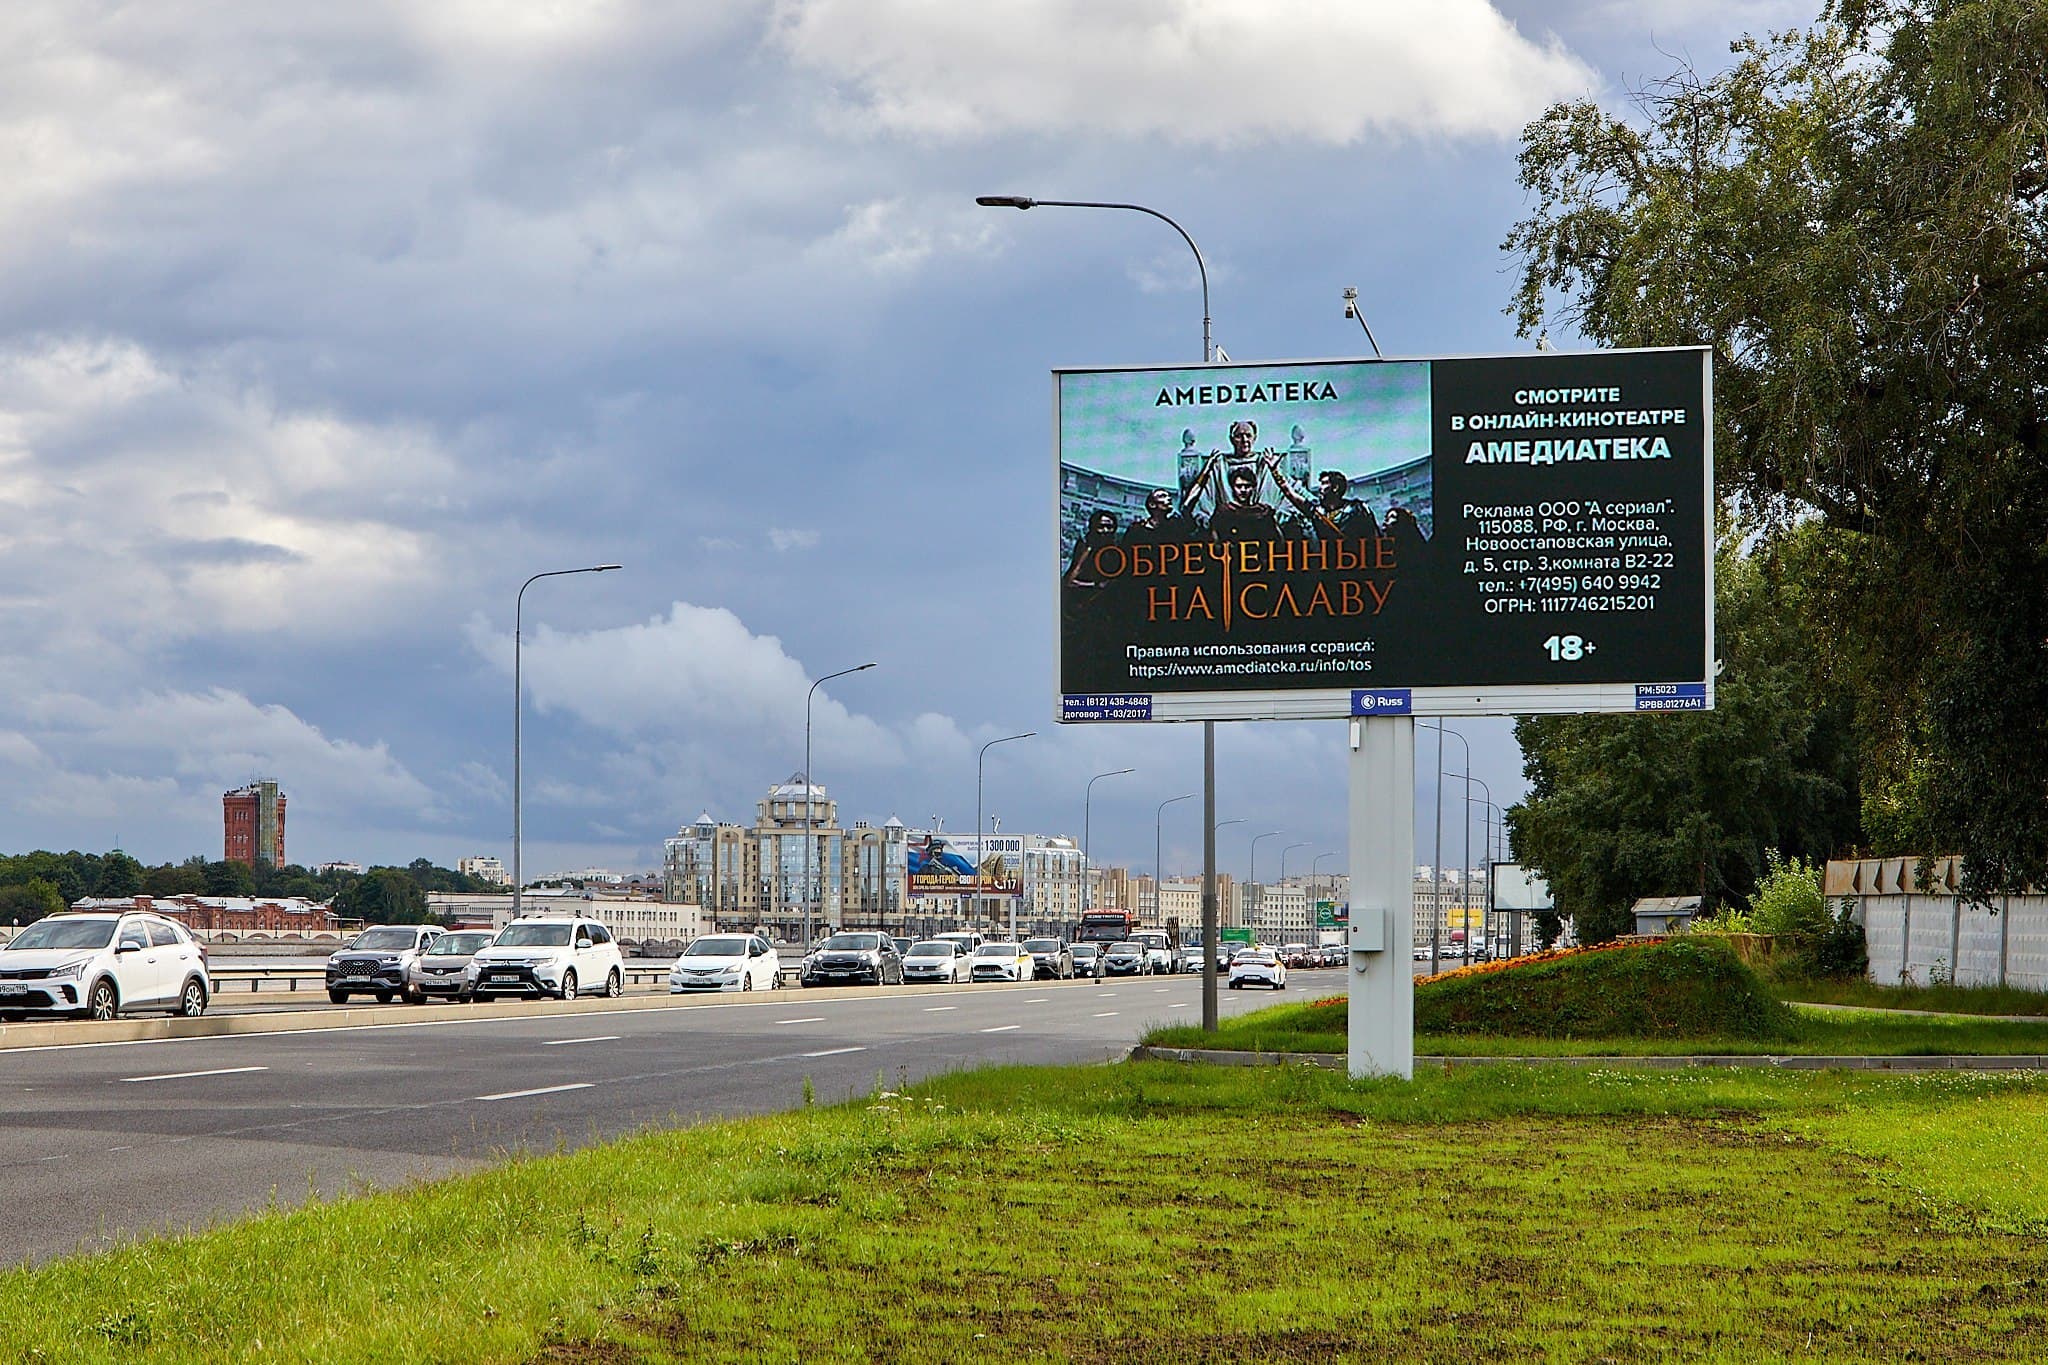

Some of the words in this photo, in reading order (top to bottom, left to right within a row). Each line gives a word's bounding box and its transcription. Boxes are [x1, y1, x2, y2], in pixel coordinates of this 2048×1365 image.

[1155, 381, 1338, 407] AMEDIATEKA
[1514, 387, 1620, 405] СМОТРИТЕ
[1451, 415, 1465, 431] В
[1468, 409, 1687, 430] ОНЛАЙН-КИНОТЕАТРЕ
[1465, 436, 1671, 465] АМЕДИАТЕКА
[1463, 504, 1534, 518] Реклама
[1538, 501, 1581, 516] ООО
[1466, 535, 1615, 551] Новоостаповская
[1094, 535, 1397, 578] ОБРЕЧЕННЫЕ
[1463, 560, 1479, 574] д.
[1502, 559, 1534, 573] стр.
[1478, 579, 1514, 593] тел.:
[1519, 576, 1578, 594] +7(495)
[1581, 575, 1614, 590] 640
[1618, 574, 1661, 589] 9942
[1148, 586, 1214, 622] НА
[1239, 579, 1396, 620] СЛАВУ
[1484, 598, 1537, 614] ОГРН:
[1540, 595, 1655, 612] 1117746215201
[1126, 645, 1190, 661] Правила
[1193, 642, 1306, 658] использования
[1310, 641, 1375, 657] сервиса:
[1543, 635, 1597, 661] 18+
[1129, 658, 1372, 679] https://www.amediateka.ru/info/tos
[1086, 697, 1108, 706] (812)
[1109, 697, 1149, 706] 438-4848
[1377, 696, 1403, 707] Russ
[1064, 711, 1102, 719] договор:
